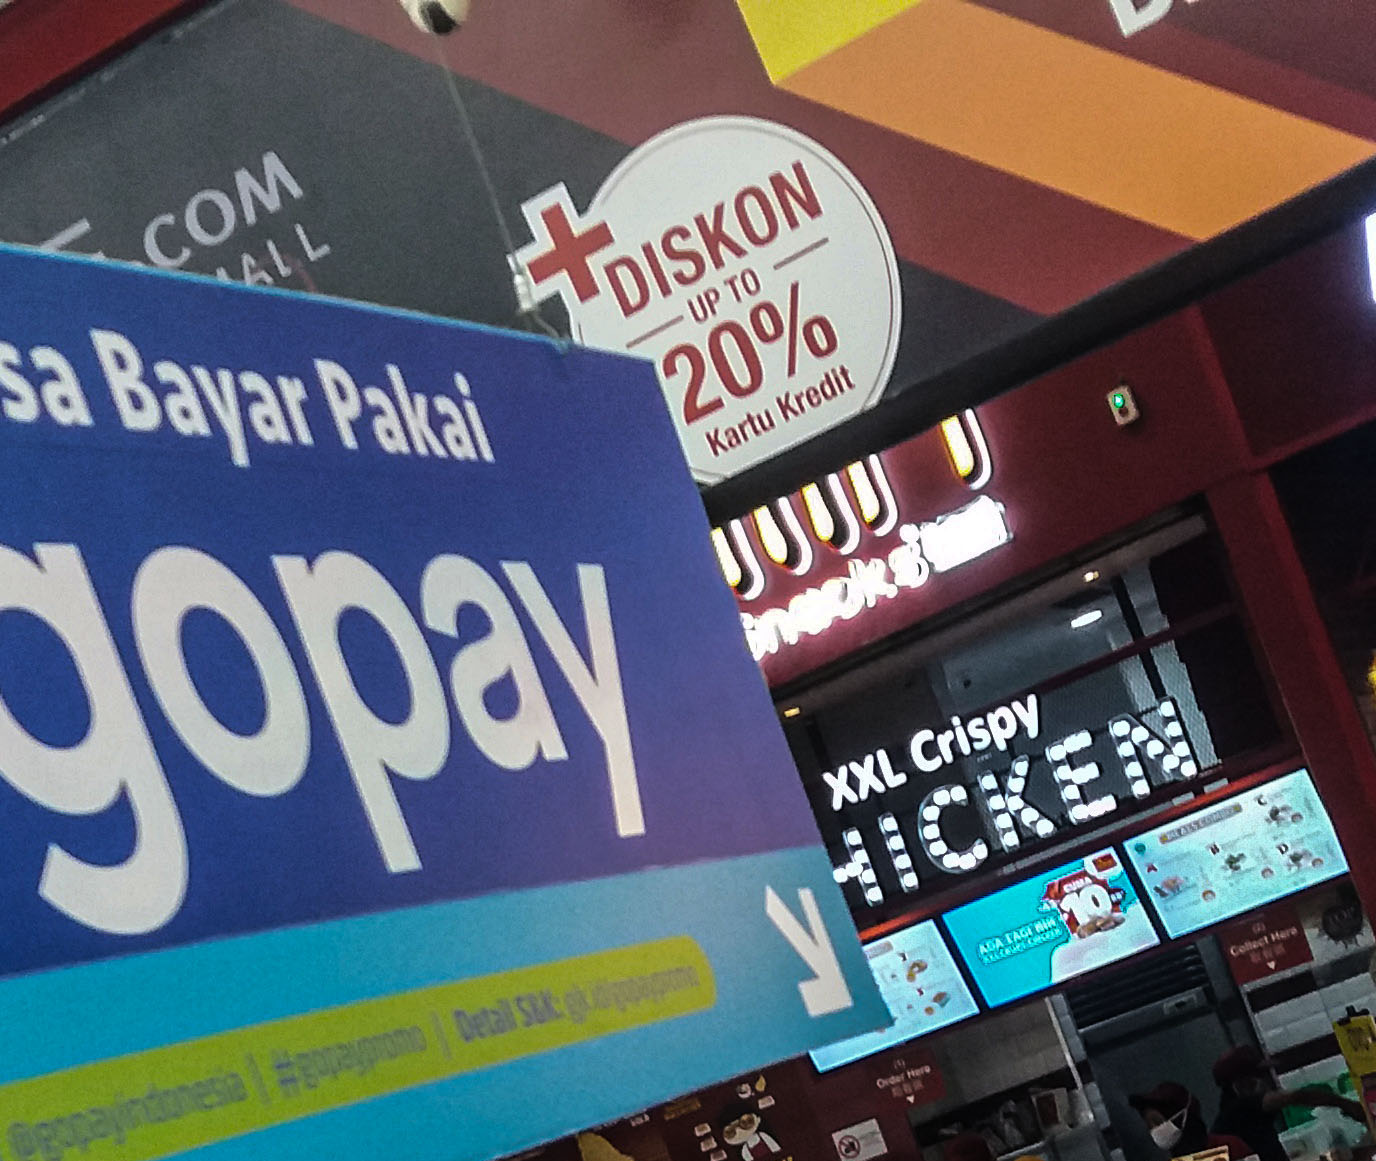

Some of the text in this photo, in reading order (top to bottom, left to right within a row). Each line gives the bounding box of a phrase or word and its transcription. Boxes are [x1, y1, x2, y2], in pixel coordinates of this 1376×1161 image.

[603, 160, 824, 318] DISKON
[687, 268, 761, 323] UP TO
[90, 329, 314, 467] Bayar
[313, 357, 495, 464] Pakai
[662, 281, 839, 426] 20%
[705, 364, 856, 457] Kartu Kredit
[823, 693, 1041, 811] XXL Crispy
[454, 999, 518, 1043] Detail
